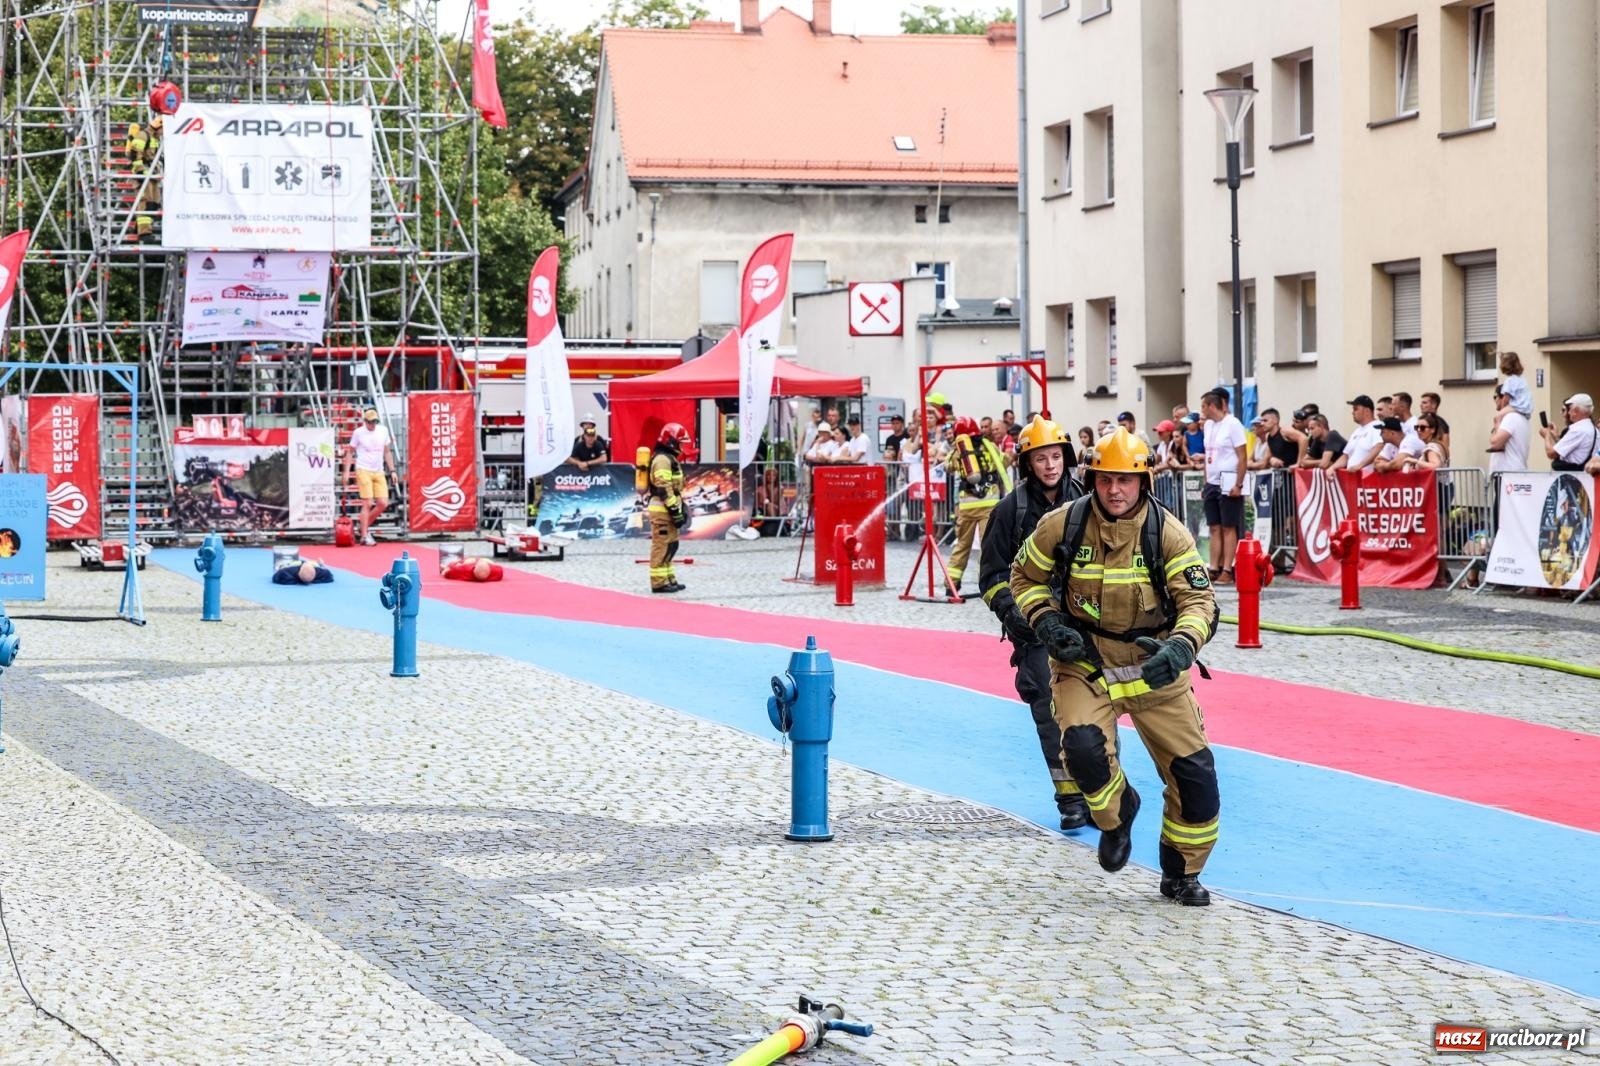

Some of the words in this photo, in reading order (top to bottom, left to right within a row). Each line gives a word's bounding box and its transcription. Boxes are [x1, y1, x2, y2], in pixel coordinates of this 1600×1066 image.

[142, 8, 248, 24] koparkiraciborz.pl
[216, 119, 364, 138] ARPAPOL
[52, 405, 63, 474] REKORD
[62, 405, 73, 473] RESCUE
[431, 402, 441, 468] REKORD
[440, 402, 451, 468] RESCUE
[555, 474, 611, 488] ostrog.net
[1357, 487, 1425, 508] REKORD
[1358, 513, 1426, 533] RESCUE
[1076, 547, 1090, 558] SP
[825, 559, 875, 571] SZECIN
